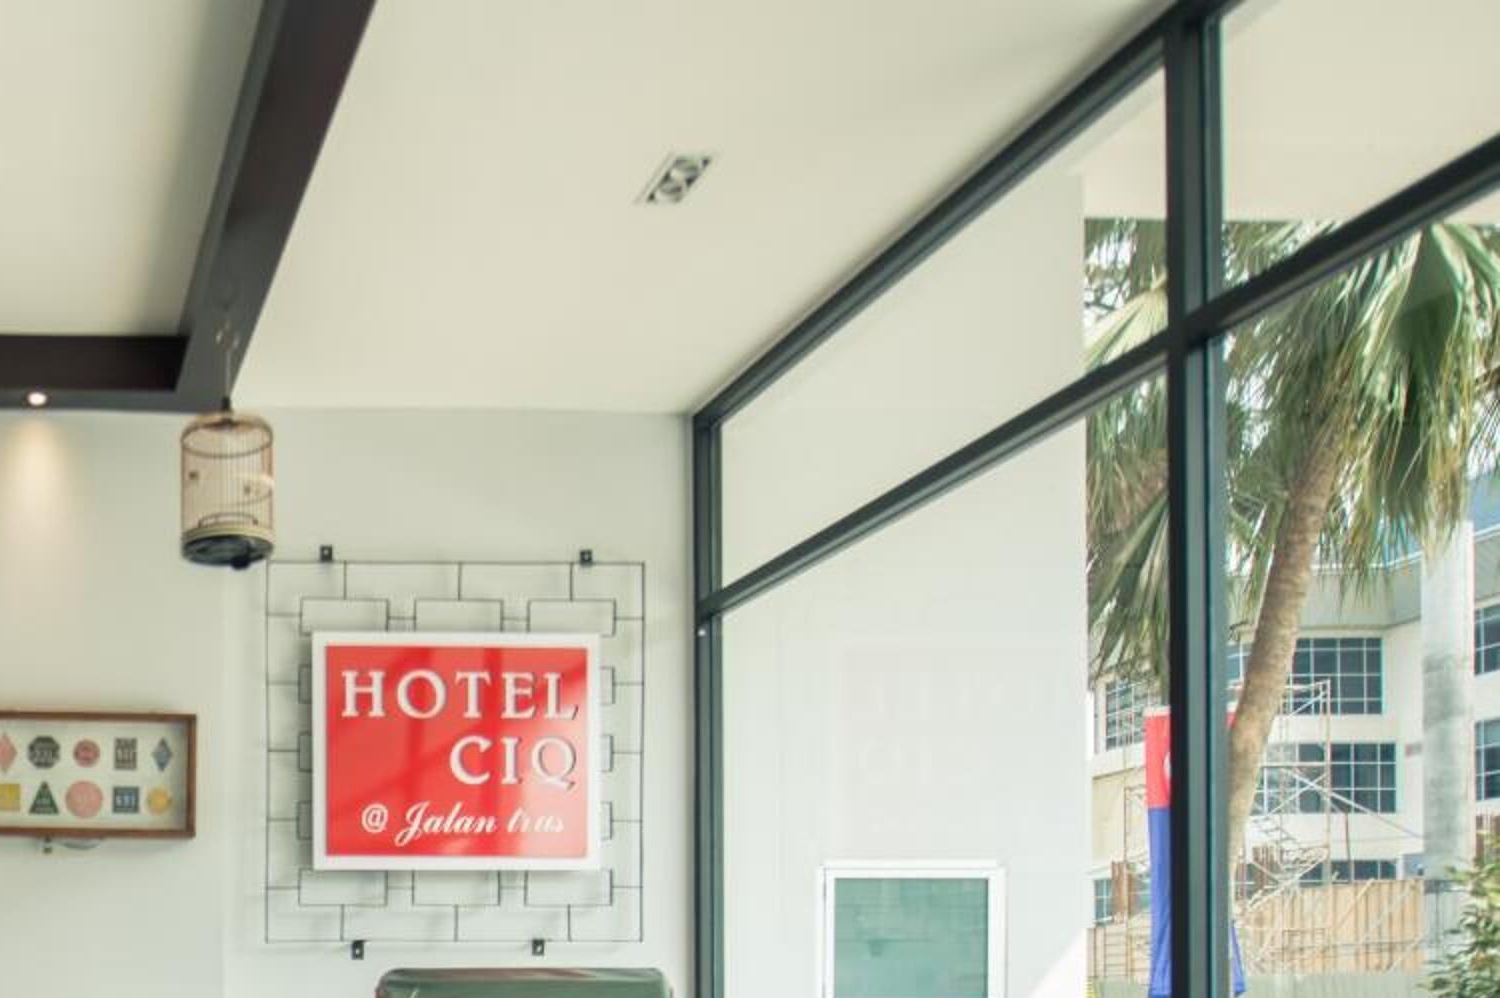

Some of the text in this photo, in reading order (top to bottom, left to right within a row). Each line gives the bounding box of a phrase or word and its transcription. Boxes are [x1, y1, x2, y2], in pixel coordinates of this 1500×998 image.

[341, 669, 579, 720] HOTEL
[450, 735, 578, 791] CIQ
[361, 803, 389, 833] @
[394, 801, 496, 846] Jalan
